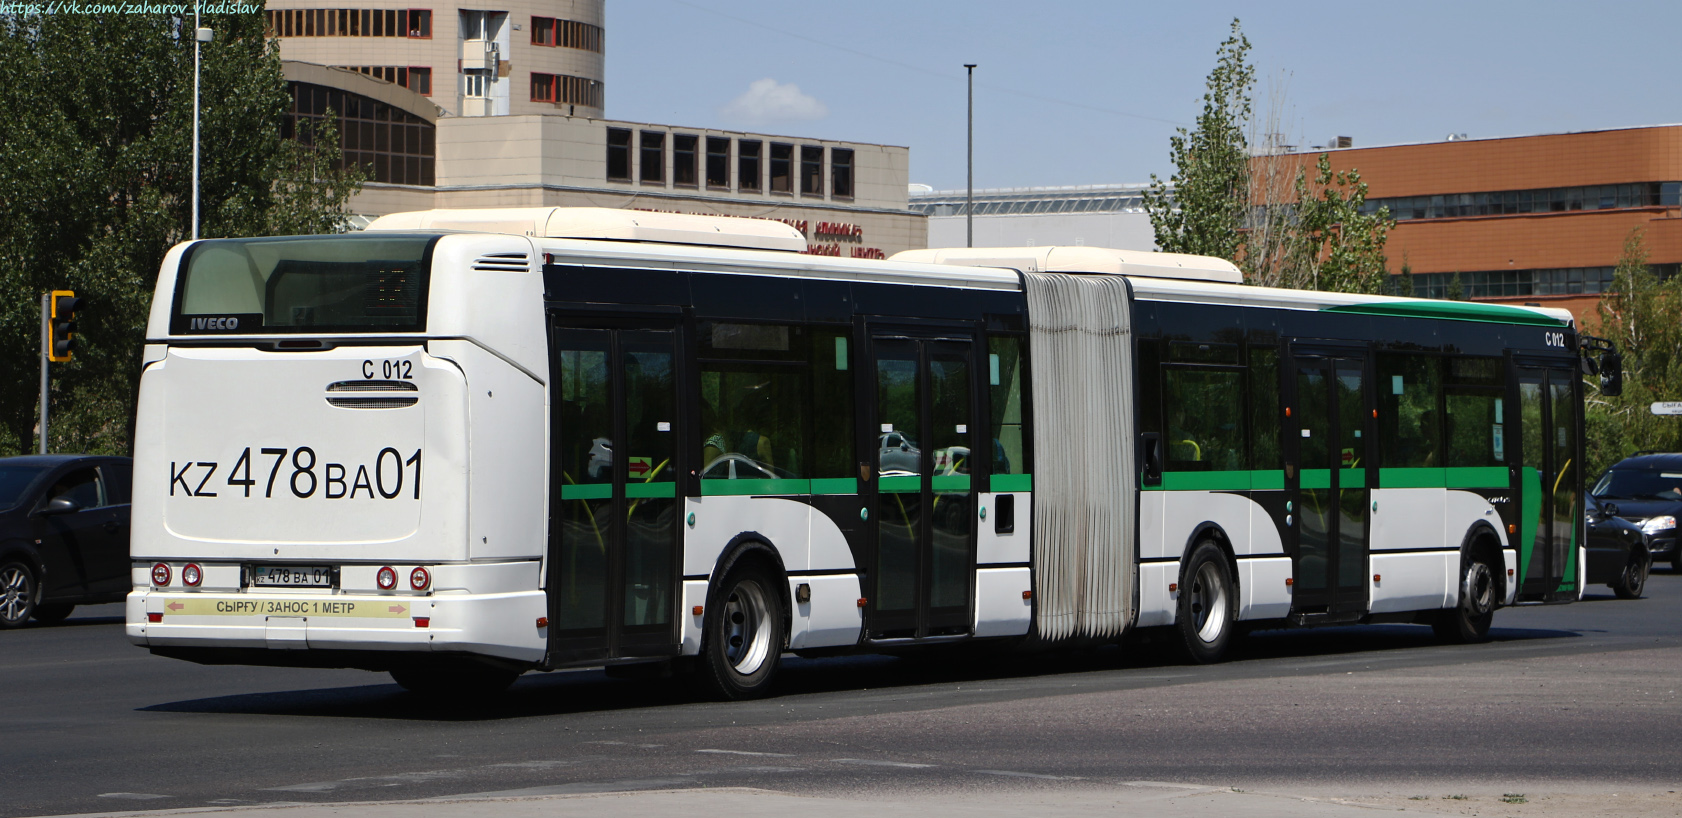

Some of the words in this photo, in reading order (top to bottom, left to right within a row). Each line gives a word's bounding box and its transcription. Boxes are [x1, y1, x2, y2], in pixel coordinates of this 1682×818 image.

[190, 317, 239, 330] IVECO
[1552, 332, 1565, 348] 012
[362, 359, 374, 380] C
[382, 359, 413, 380] 012
[169, 461, 218, 498] KZ
[268, 568, 291, 583] 478
[313, 568, 329, 584] 01
[216, 601, 258, 613] СЫРҒУ
[267, 602, 309, 613] ЗАНОС
[312, 602, 318, 613] 1
[322, 602, 355, 614] МЕТР
